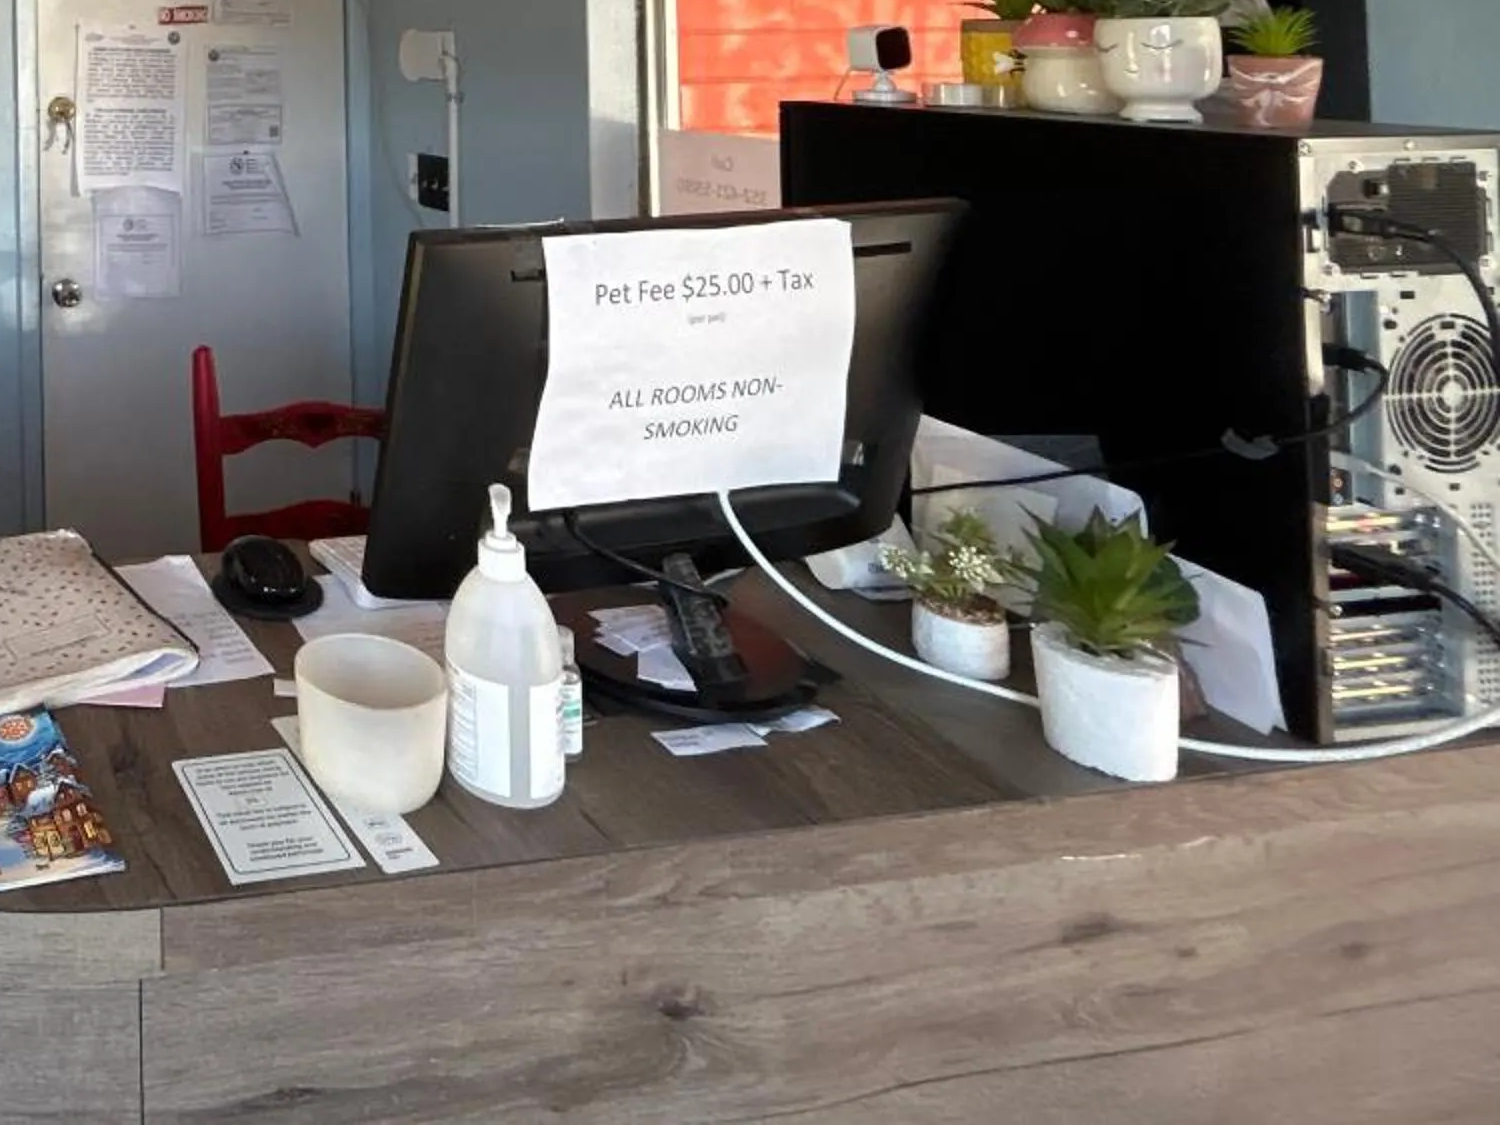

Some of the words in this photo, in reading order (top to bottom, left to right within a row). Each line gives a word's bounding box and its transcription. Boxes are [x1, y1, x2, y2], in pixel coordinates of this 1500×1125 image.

[594, 283, 631, 306] Pet
[638, 280, 676, 302] Fee
[681, 272, 754, 303] $25.00
[759, 276, 773, 290] +
[776, 269, 814, 292] Tax
[608, 388, 645, 410] ALL
[650, 381, 727, 406] ROOMS
[731, 376, 784, 398] NON-
[642, 414, 740, 441] SMOKING
